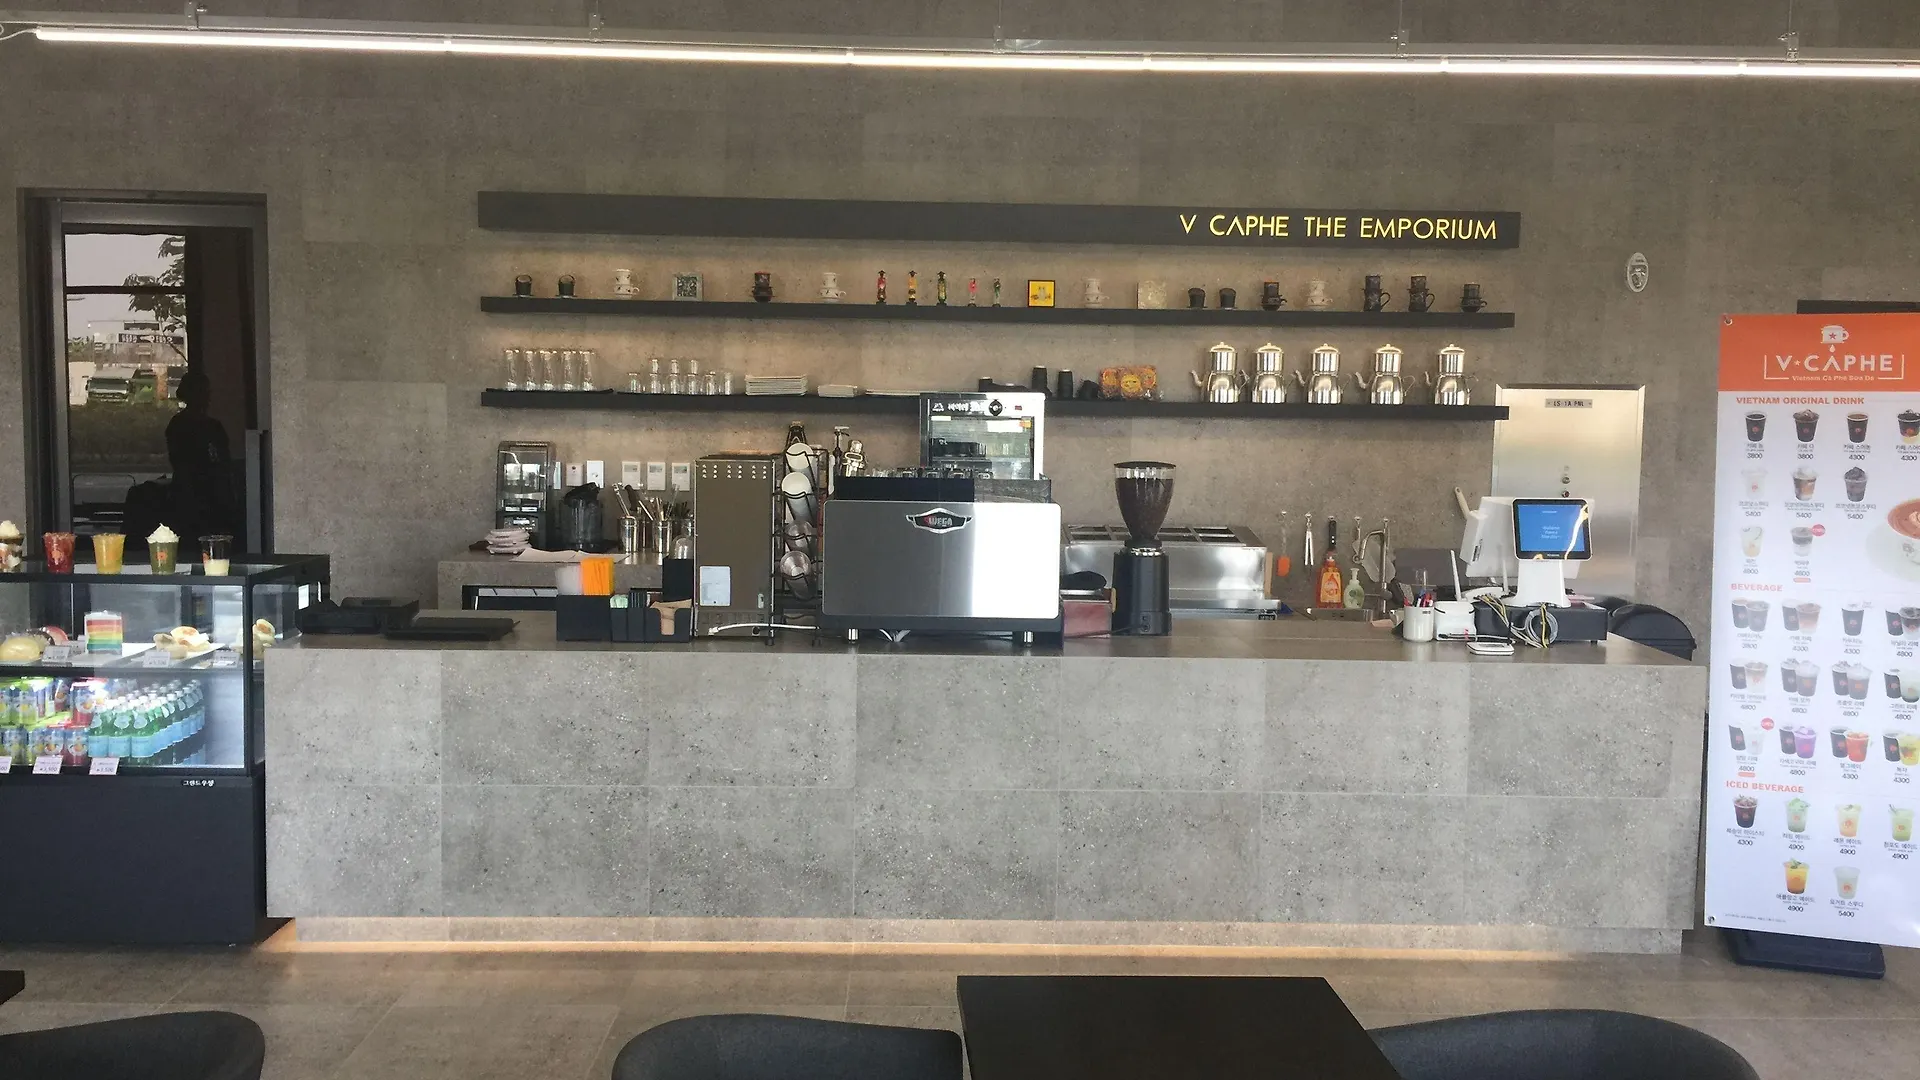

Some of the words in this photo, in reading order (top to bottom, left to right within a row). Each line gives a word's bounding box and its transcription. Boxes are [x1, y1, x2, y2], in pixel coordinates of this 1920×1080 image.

[1179, 214, 1197, 234] V
[1209, 214, 1290, 237] CAPHE
[1304, 216, 1347, 238] THE
[1360, 217, 1497, 240] EMPORIUM
[1833, 397, 1865, 405] DRINK
[928, 517, 953, 527] WEGA
[1731, 583, 1783, 592] BEVERAGE
[1726, 780, 1748, 789] ICED
[1751, 782, 1804, 793] BEVERAGE
